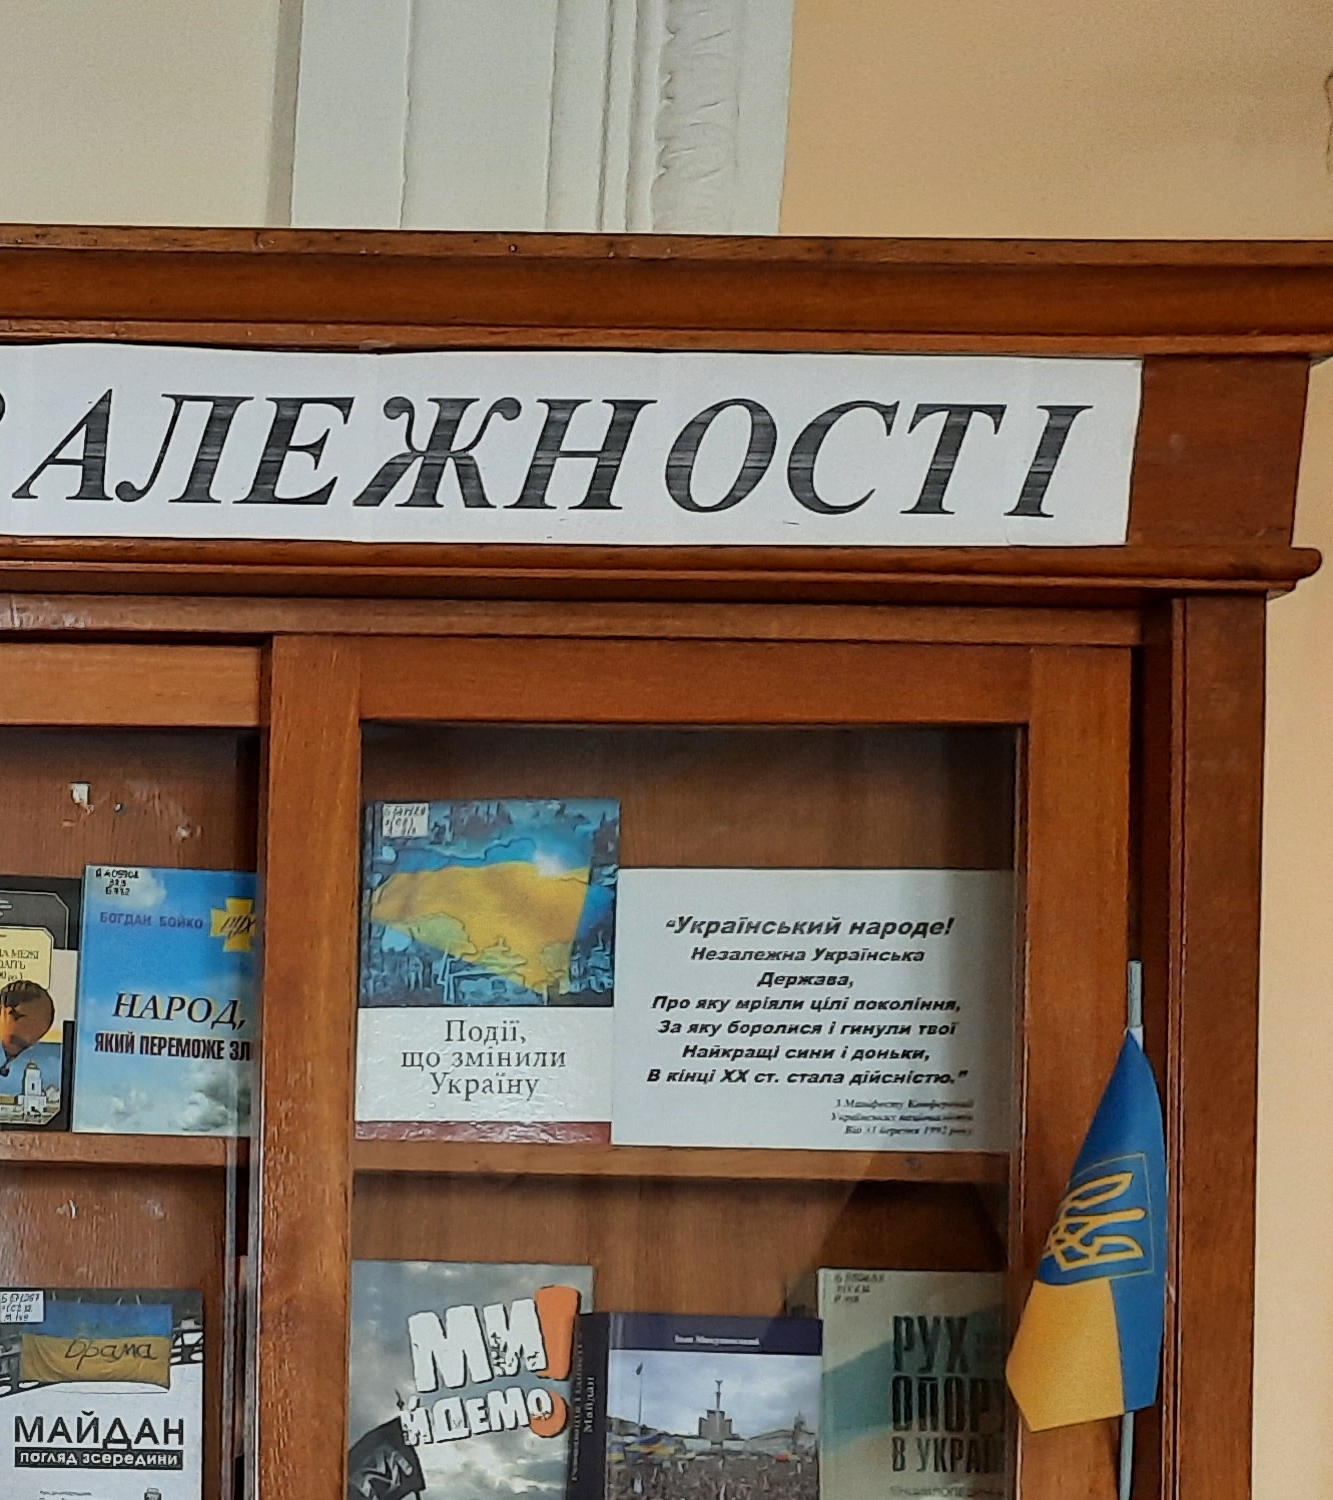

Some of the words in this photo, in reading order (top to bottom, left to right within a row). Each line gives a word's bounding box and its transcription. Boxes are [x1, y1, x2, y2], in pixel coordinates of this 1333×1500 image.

[100, 912, 151, 926] БОГДАН
[159, 915, 203, 929] БОЙКО
[849, 917, 955, 939] народе!
[691, 947, 806, 962] Незалежна
[811, 948, 925, 964] Українська
[757, 971, 854, 989] Держава,
[112, 992, 246, 1031] НАРОД,
[651, 996, 691, 1012] Про
[696, 998, 730, 1013] яку
[736, 997, 805, 1013] мріяли
[810, 997, 848, 1012] цілі
[853, 998, 961, 1013] покоління,
[445, 1019, 526, 1045] Події,
[658, 1021, 682, 1034] За
[687, 1023, 721, 1037] яку
[727, 1021, 822, 1037] боролися
[840, 1023, 913, 1037] гинули
[919, 1023, 958, 1036] твої
[94, 1030, 135, 1055] ЯКИЙ
[140, 1036, 224, 1060] ПЕРЕМОЖЕ
[682, 1045, 780, 1062] Найкращі
[785, 1047, 835, 1060] сини
[851, 1049, 930, 1063] доньки,
[401, 1051, 441, 1070] що
[451, 1046, 566, 1069] змінили
[430, 1072, 540, 1101] Україну
[646, 1069, 660, 1082] В
[666, 1069, 715, 1085] кінці
[754, 1072, 780, 1084] ст.
[786, 1072, 844, 1084] стала
[893, 1315, 969, 1374] РУХ
[14, 1410, 184, 1451] МАЙДАН
[892, 1436, 907, 1473] В
